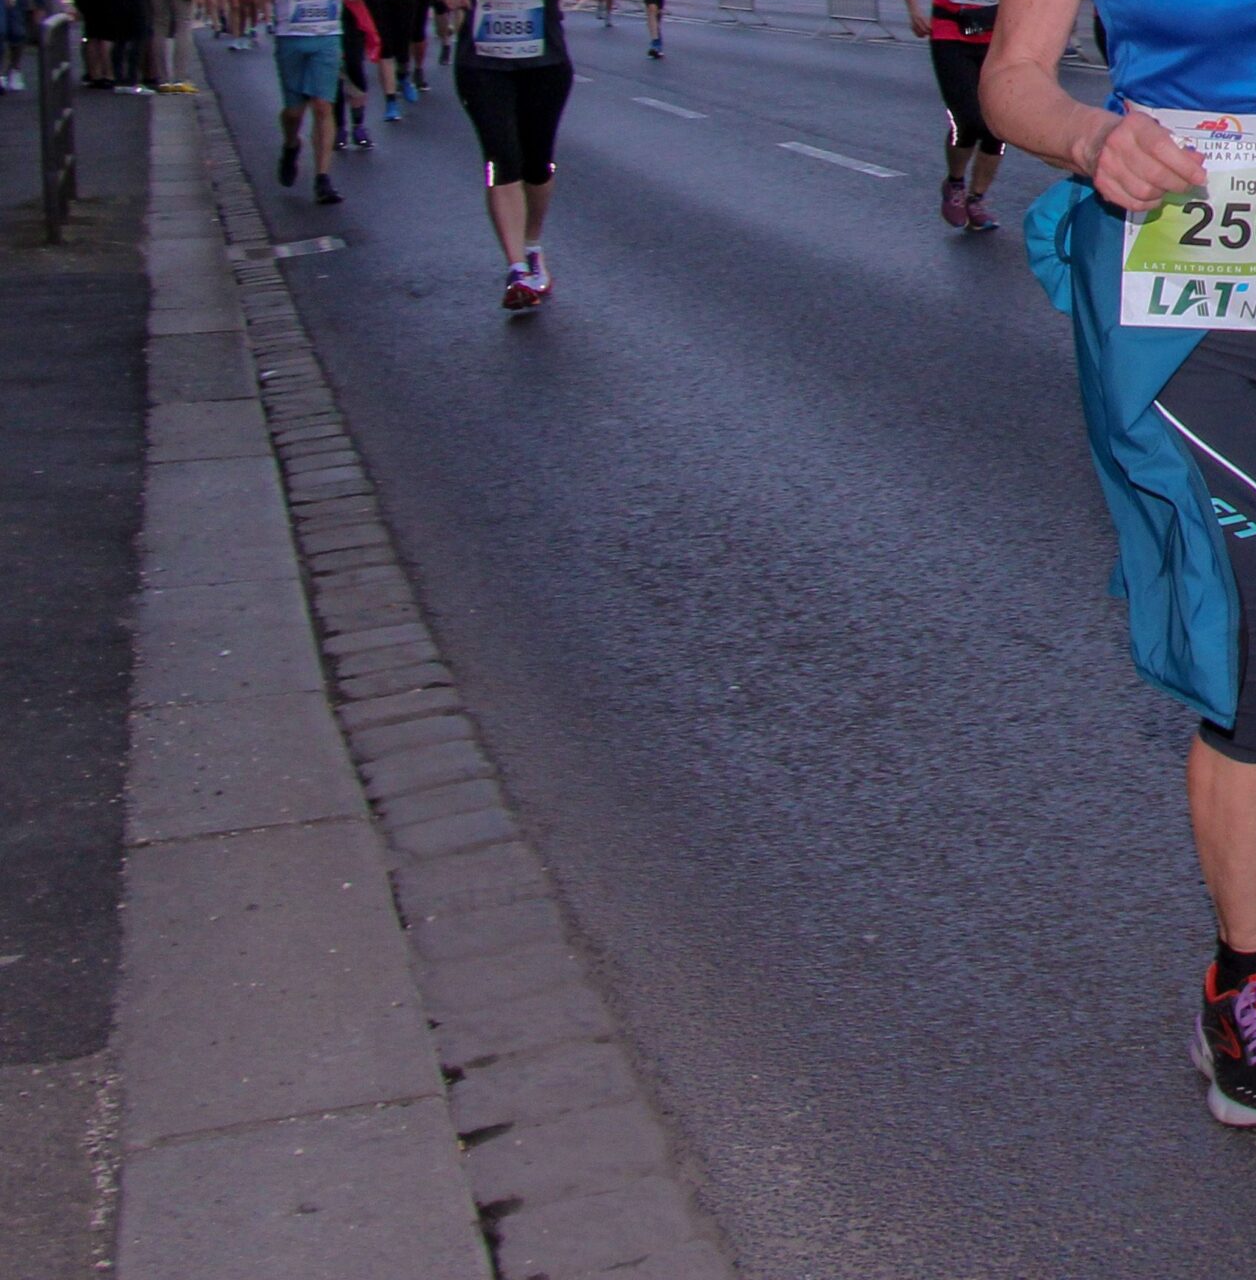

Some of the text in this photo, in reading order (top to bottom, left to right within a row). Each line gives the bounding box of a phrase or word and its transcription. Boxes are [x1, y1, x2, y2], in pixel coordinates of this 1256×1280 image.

[486, 21, 534, 35] 10888
[1204, 141, 1229, 150] LINZ
[1143, 262, 1166, 270] LAT
[1175, 264, 1242, 273] NITROGEN
[1148, 276, 1236, 318] LAT
